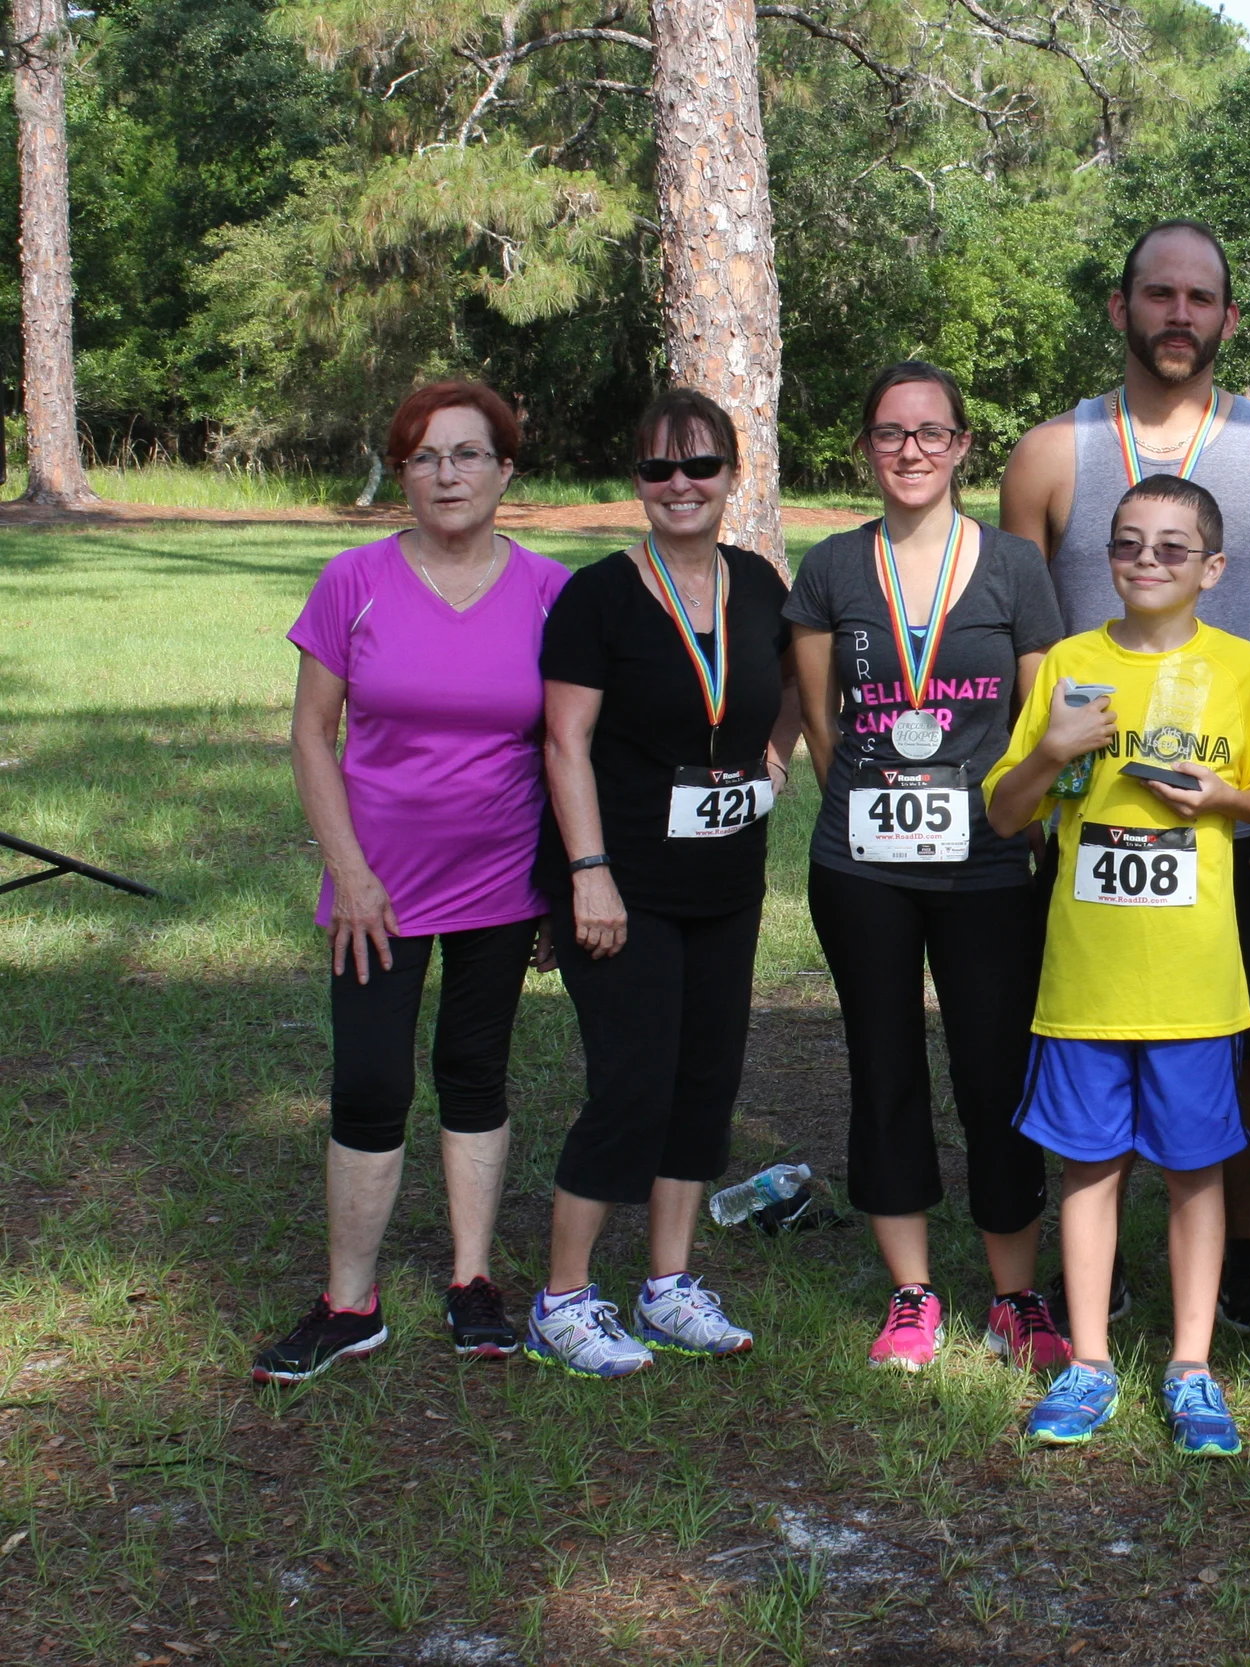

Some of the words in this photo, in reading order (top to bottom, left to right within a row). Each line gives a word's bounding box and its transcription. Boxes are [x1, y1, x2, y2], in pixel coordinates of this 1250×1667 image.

[855, 707, 953, 735] CANR
[897, 722, 925, 730] CIRCLE
[896, 730, 940, 743] HOPE
[696, 785, 757, 829] 421
[868, 792, 952, 833] 405
[875, 833, 943, 841] www.RoadID.com
[1092, 850, 1179, 897] 408
[1097, 894, 1169, 905] www.RoadID.com
